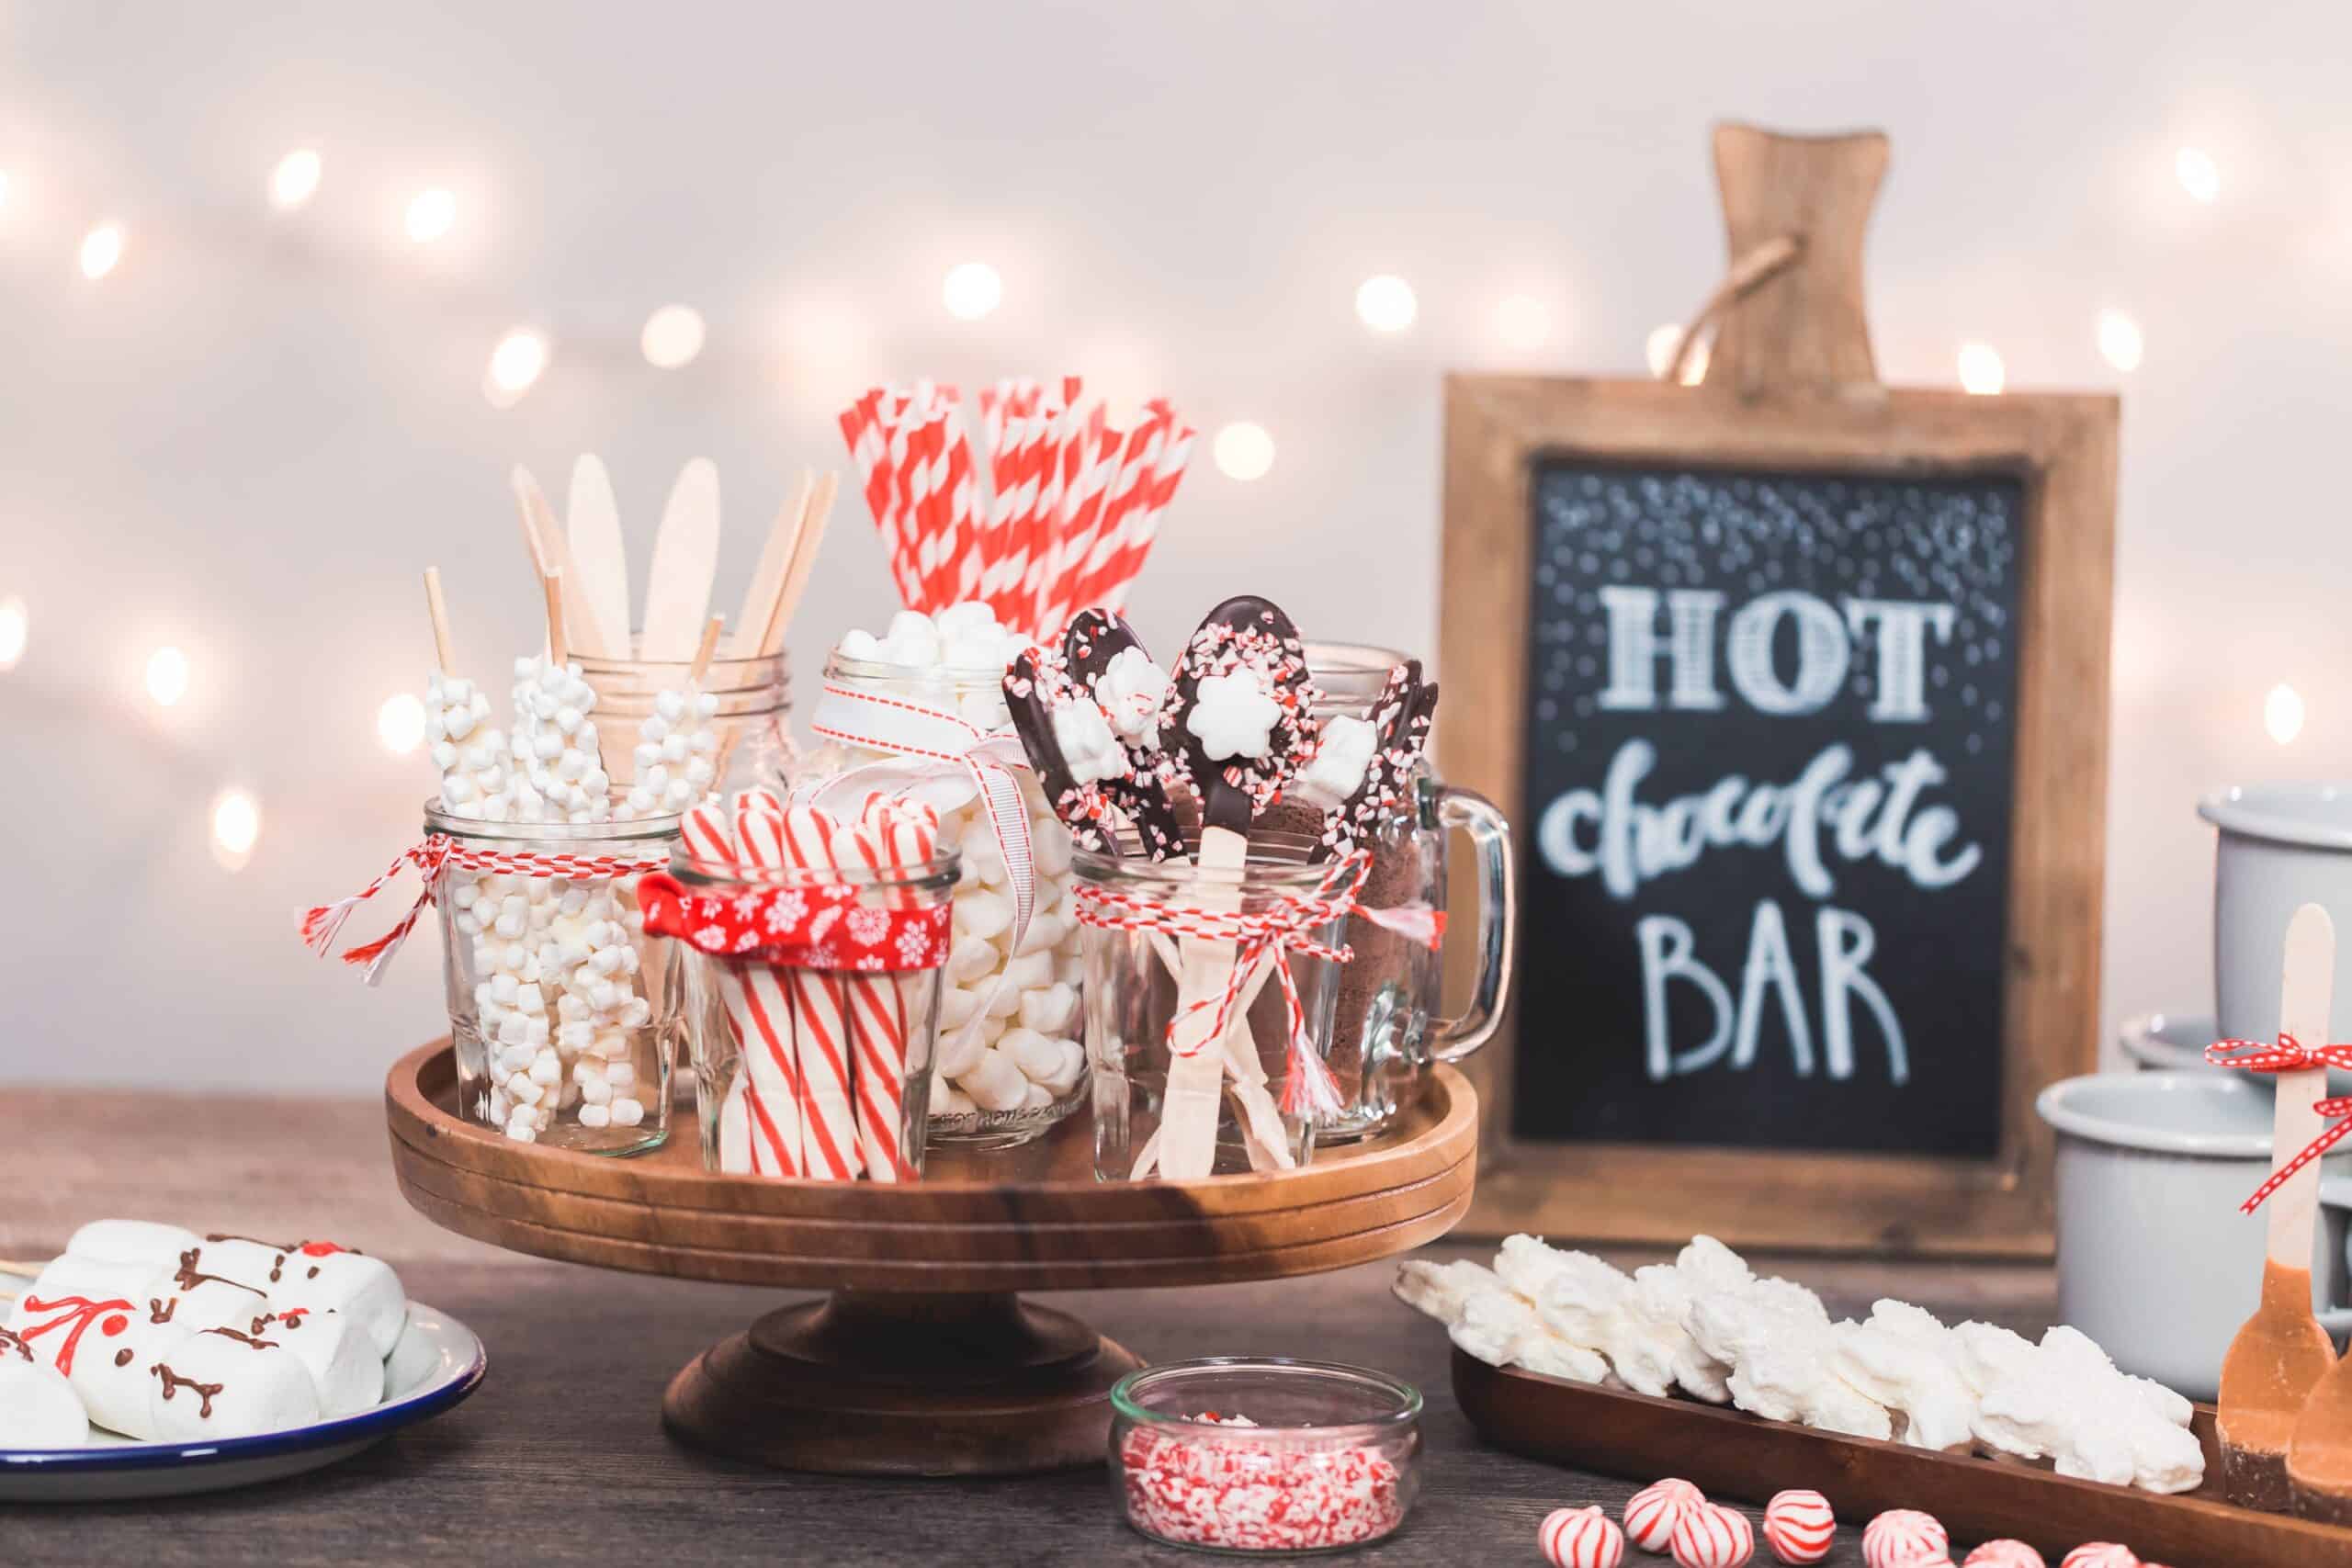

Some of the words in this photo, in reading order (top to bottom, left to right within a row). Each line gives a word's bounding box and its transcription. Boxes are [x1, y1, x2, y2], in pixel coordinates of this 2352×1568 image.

[1597, 584, 1958, 722] HOT
[1539, 739, 1982, 898] chocolate
[1637, 900, 1908, 1081] BAR
